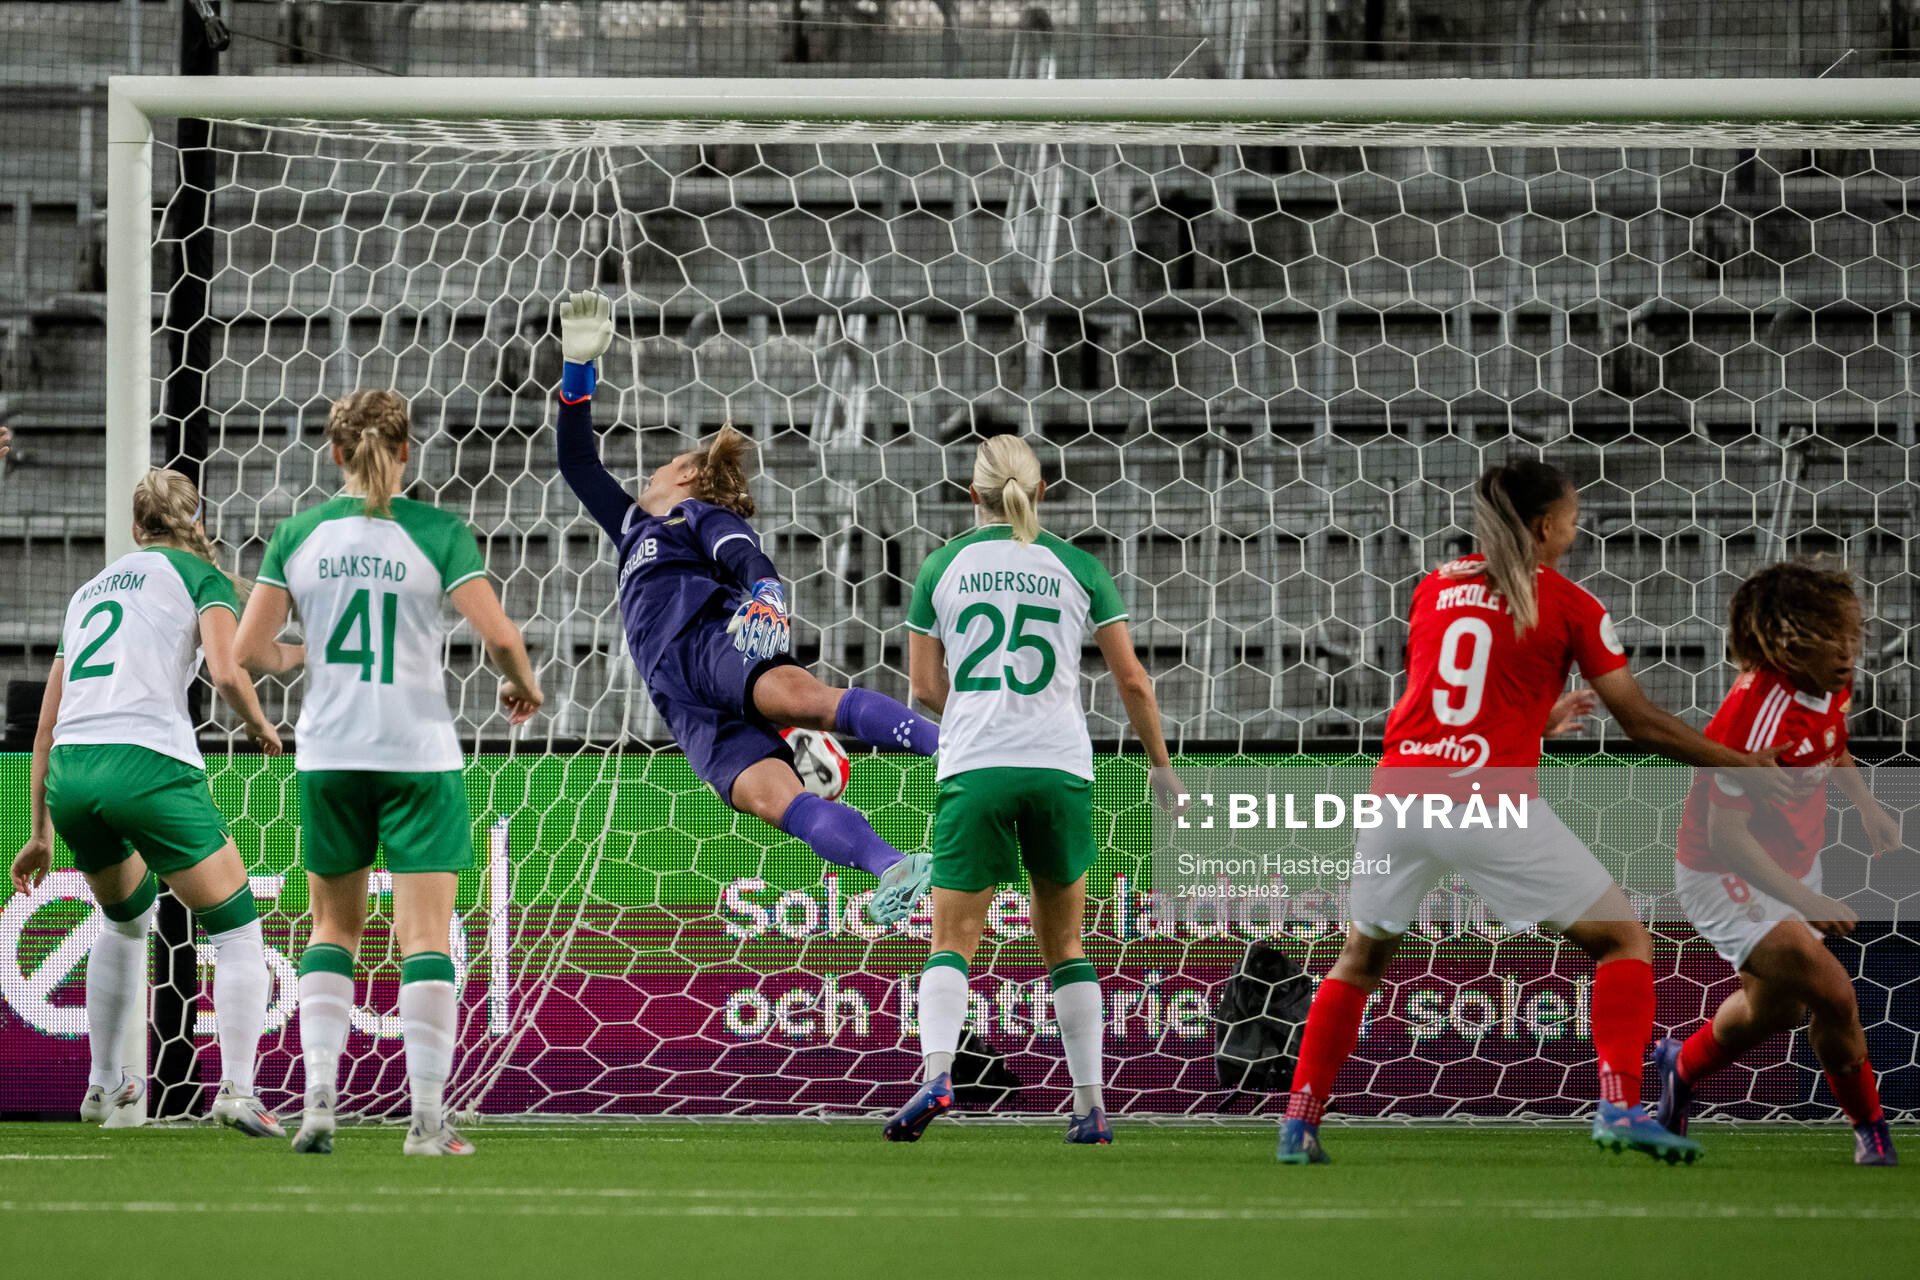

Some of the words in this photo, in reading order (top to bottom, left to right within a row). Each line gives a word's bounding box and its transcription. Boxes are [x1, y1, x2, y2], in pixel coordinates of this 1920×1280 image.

[79, 570, 147, 603] NYSTRÖM
[319, 555, 407, 582] BLAKSTAD
[958, 571, 1062, 598] ANDERSSON
[69, 599, 124, 682] 2
[325, 588, 398, 685] 41
[954, 601, 1062, 696] 25
[1432, 616, 1493, 727] 9
[724, 972, 870, 1037] och
